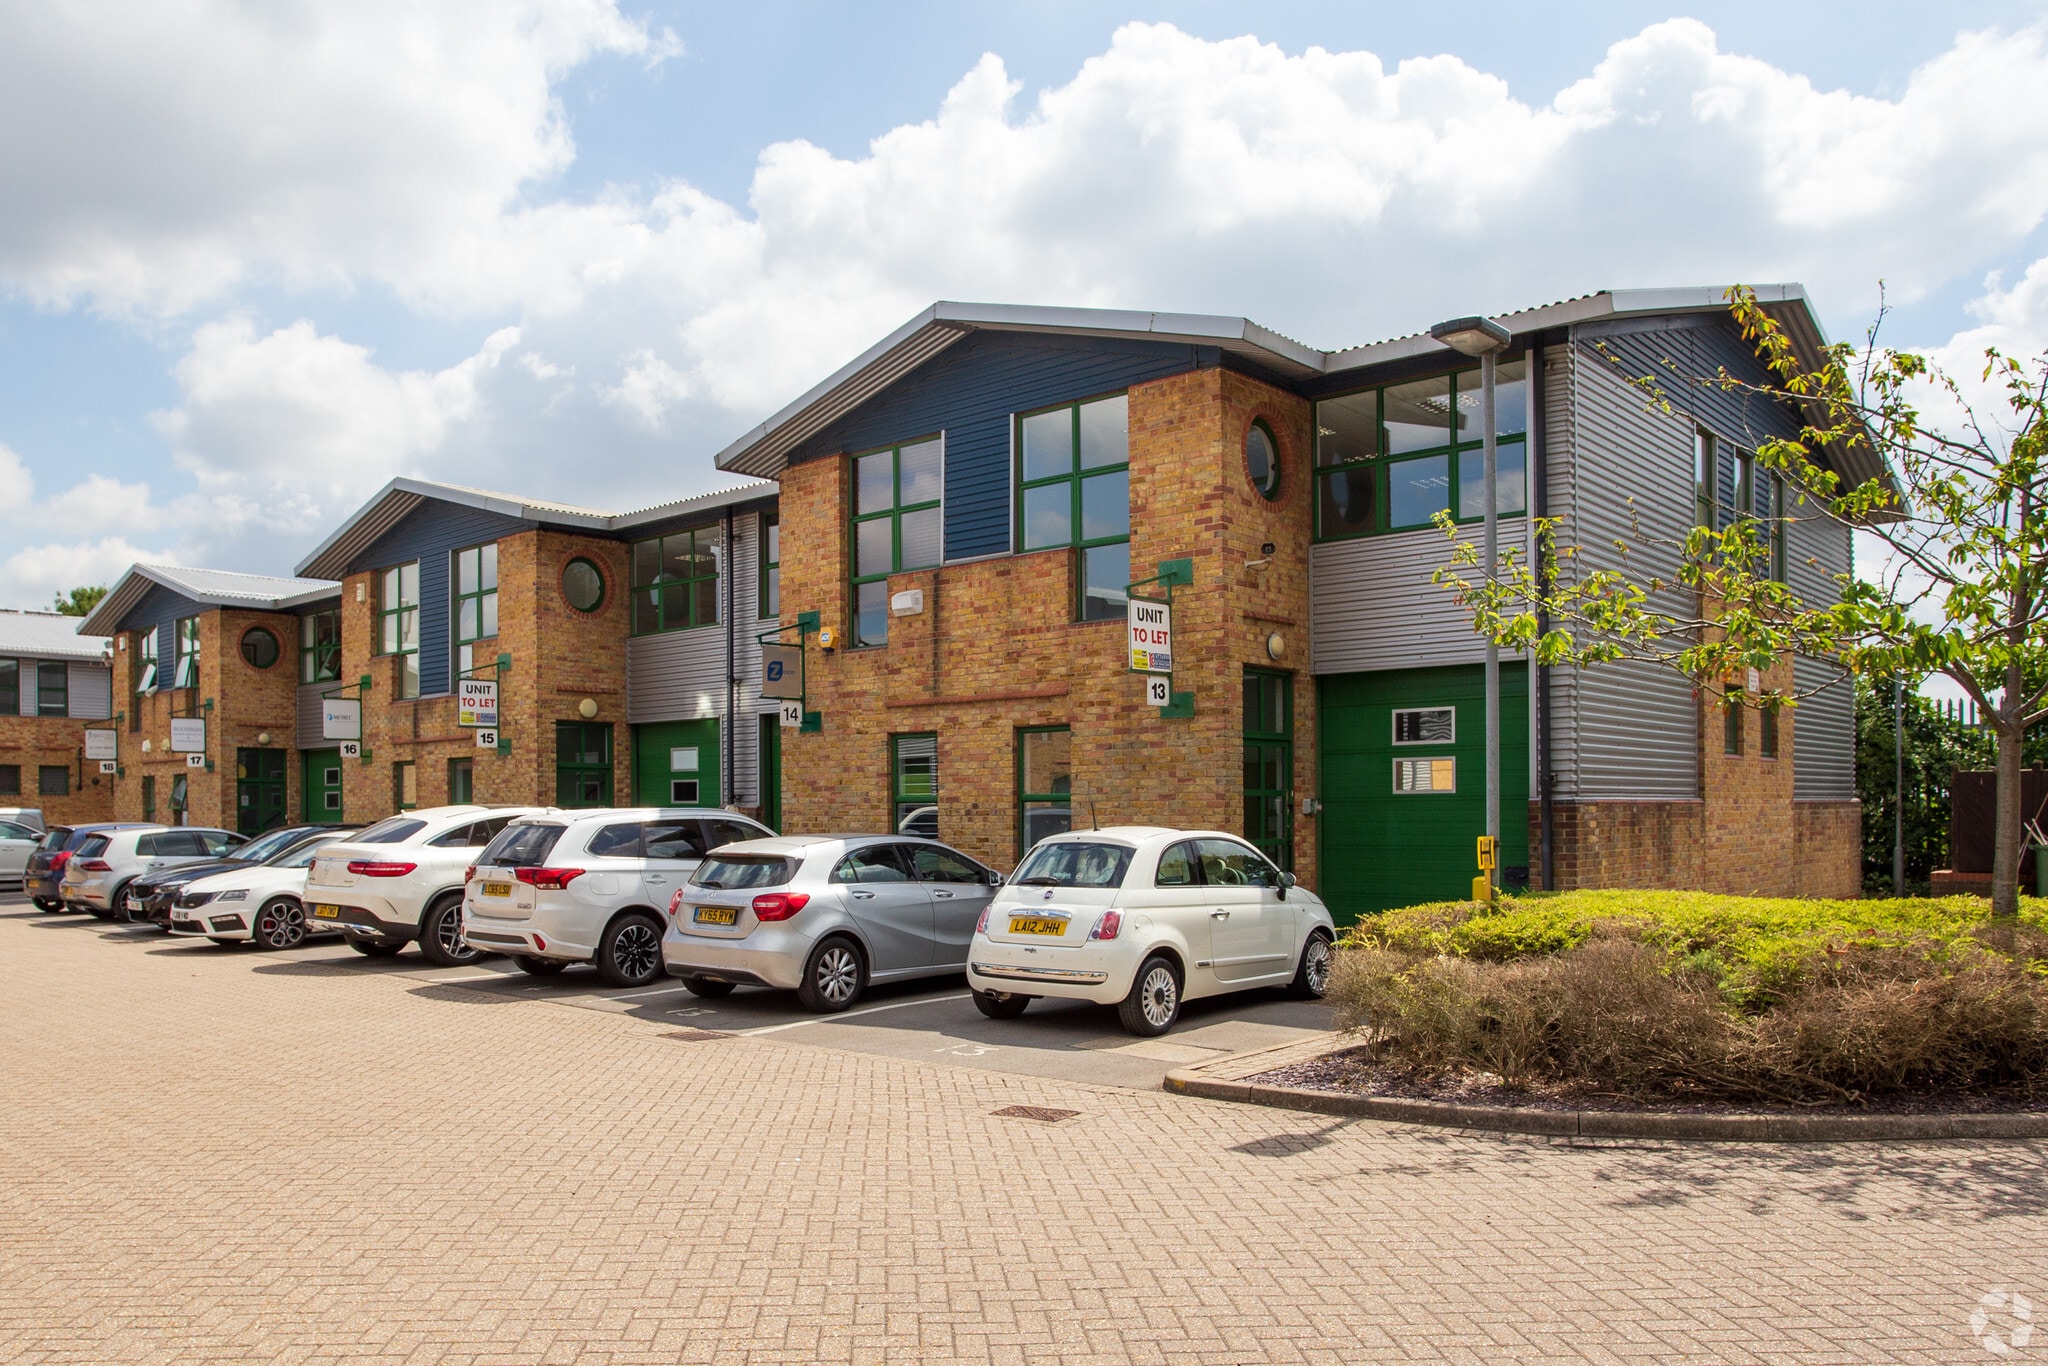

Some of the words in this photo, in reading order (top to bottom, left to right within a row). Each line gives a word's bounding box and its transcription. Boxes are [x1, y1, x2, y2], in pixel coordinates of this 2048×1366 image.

[1137, 607, 1163, 624] UNIT
[1133, 627, 1148, 643] TO
[1151, 630, 1168, 645] LET
[466, 684, 491, 694] UNIT
[1151, 682, 1166, 700] 13
[461, 697, 476, 707] TO
[479, 698, 496, 708] LET
[783, 706, 799, 721] 14
[480, 732, 494, 744] 15
[343, 744, 357, 754] 16
[190, 756, 202, 765] 17
[102, 763, 114, 771] 18
[1480, 839, 1493, 866] H
[698, 909, 718, 920] KY65
[1015, 921, 1037, 932] LA12
[1038, 922, 1060, 934] JHH
